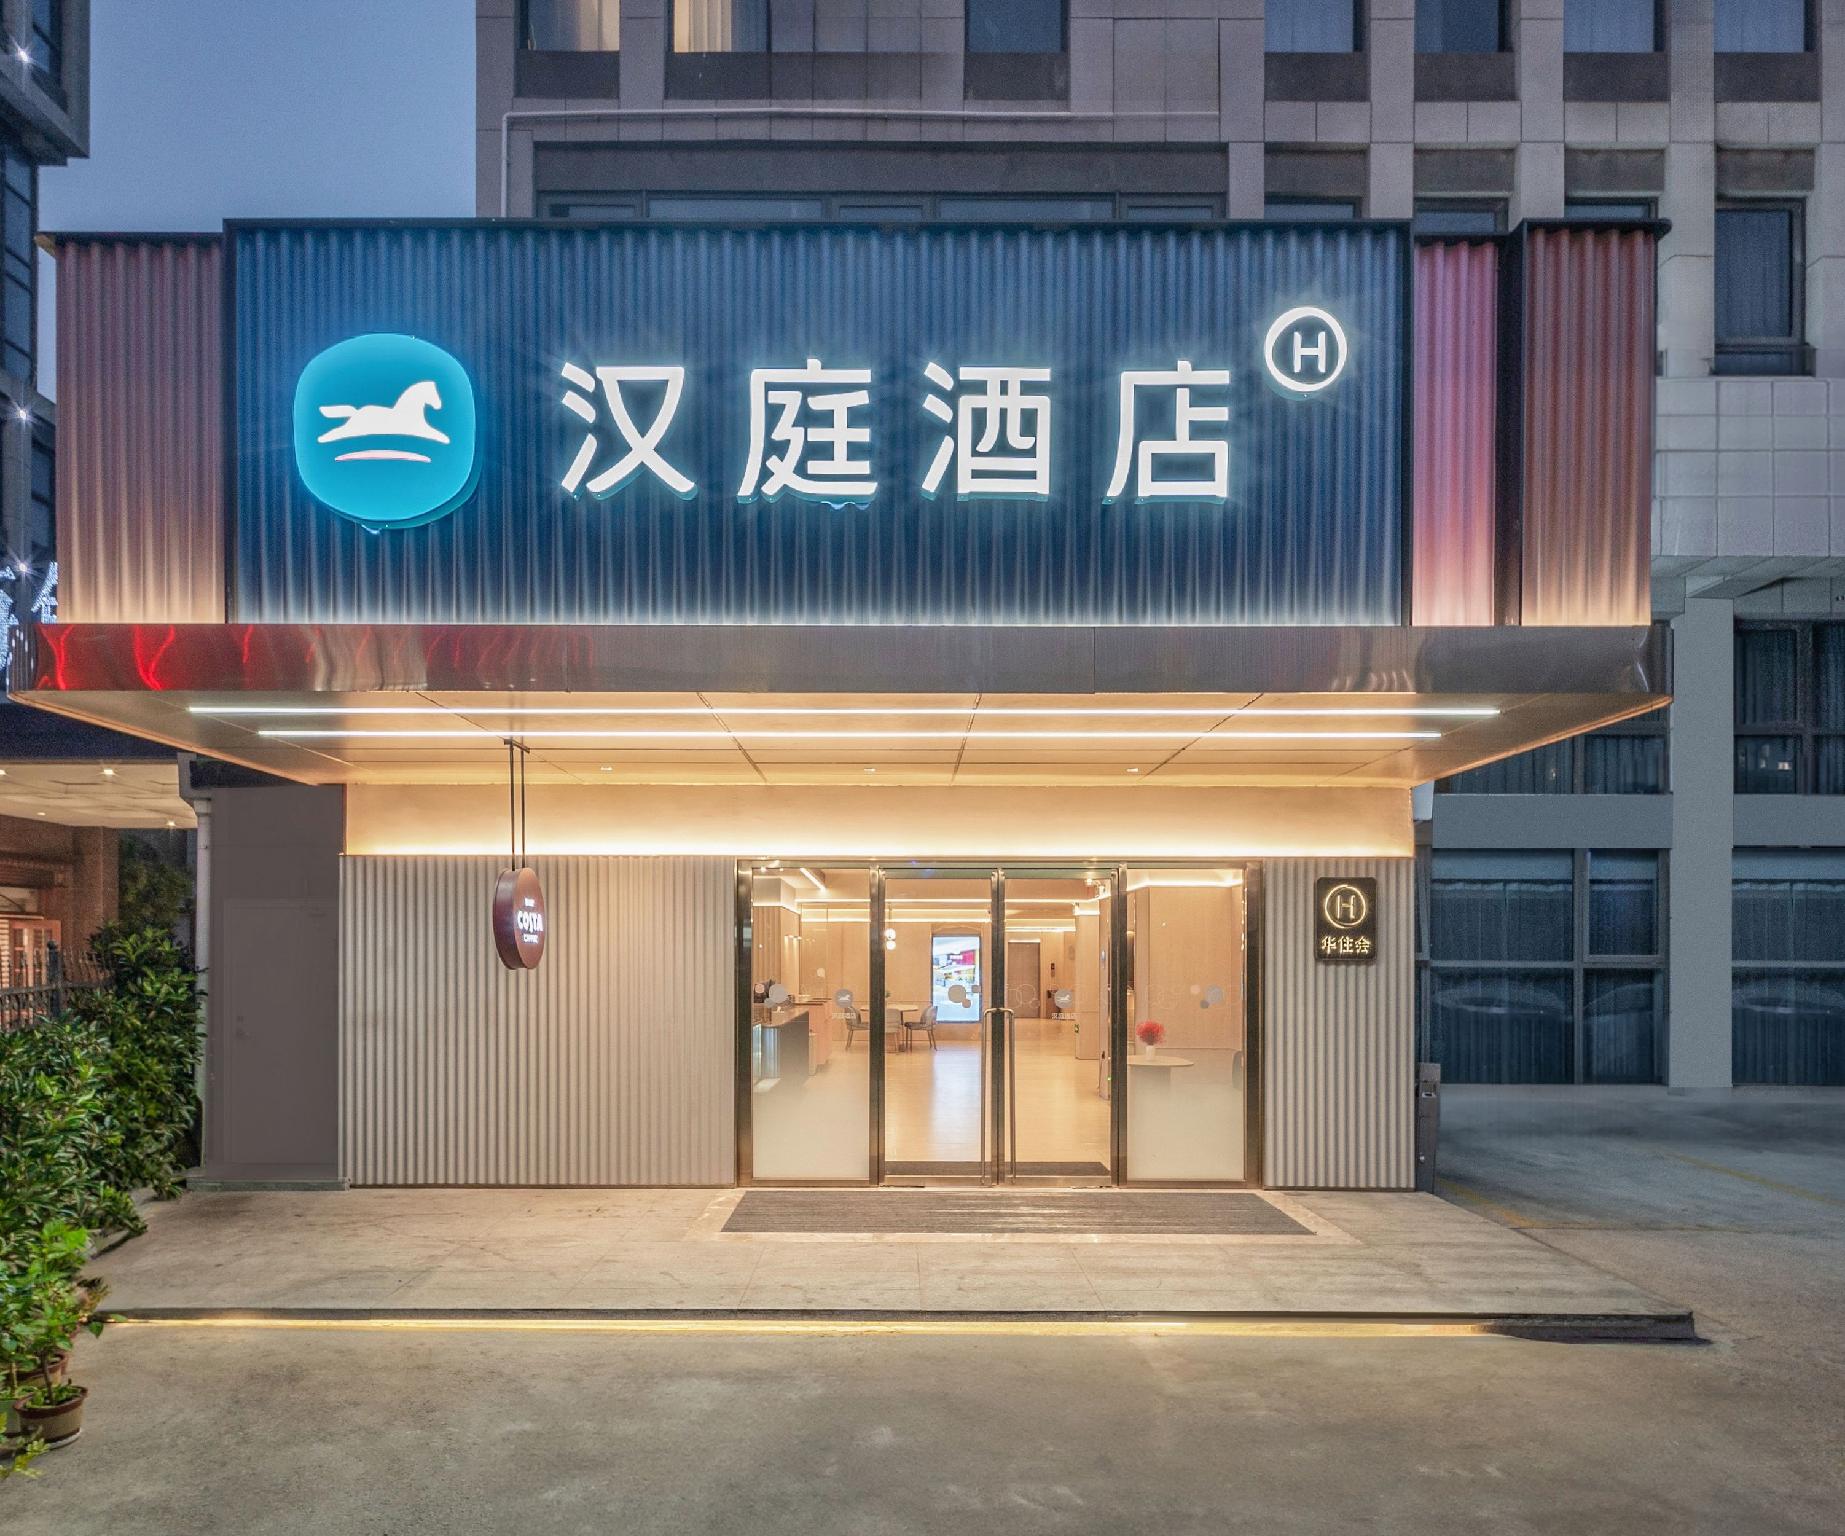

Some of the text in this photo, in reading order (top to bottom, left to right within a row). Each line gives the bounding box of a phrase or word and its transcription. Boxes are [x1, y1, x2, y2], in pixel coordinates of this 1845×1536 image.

[561, 358, 1229, 497] 汉庭酒店
[1321, 935, 1371, 955] 华住会
